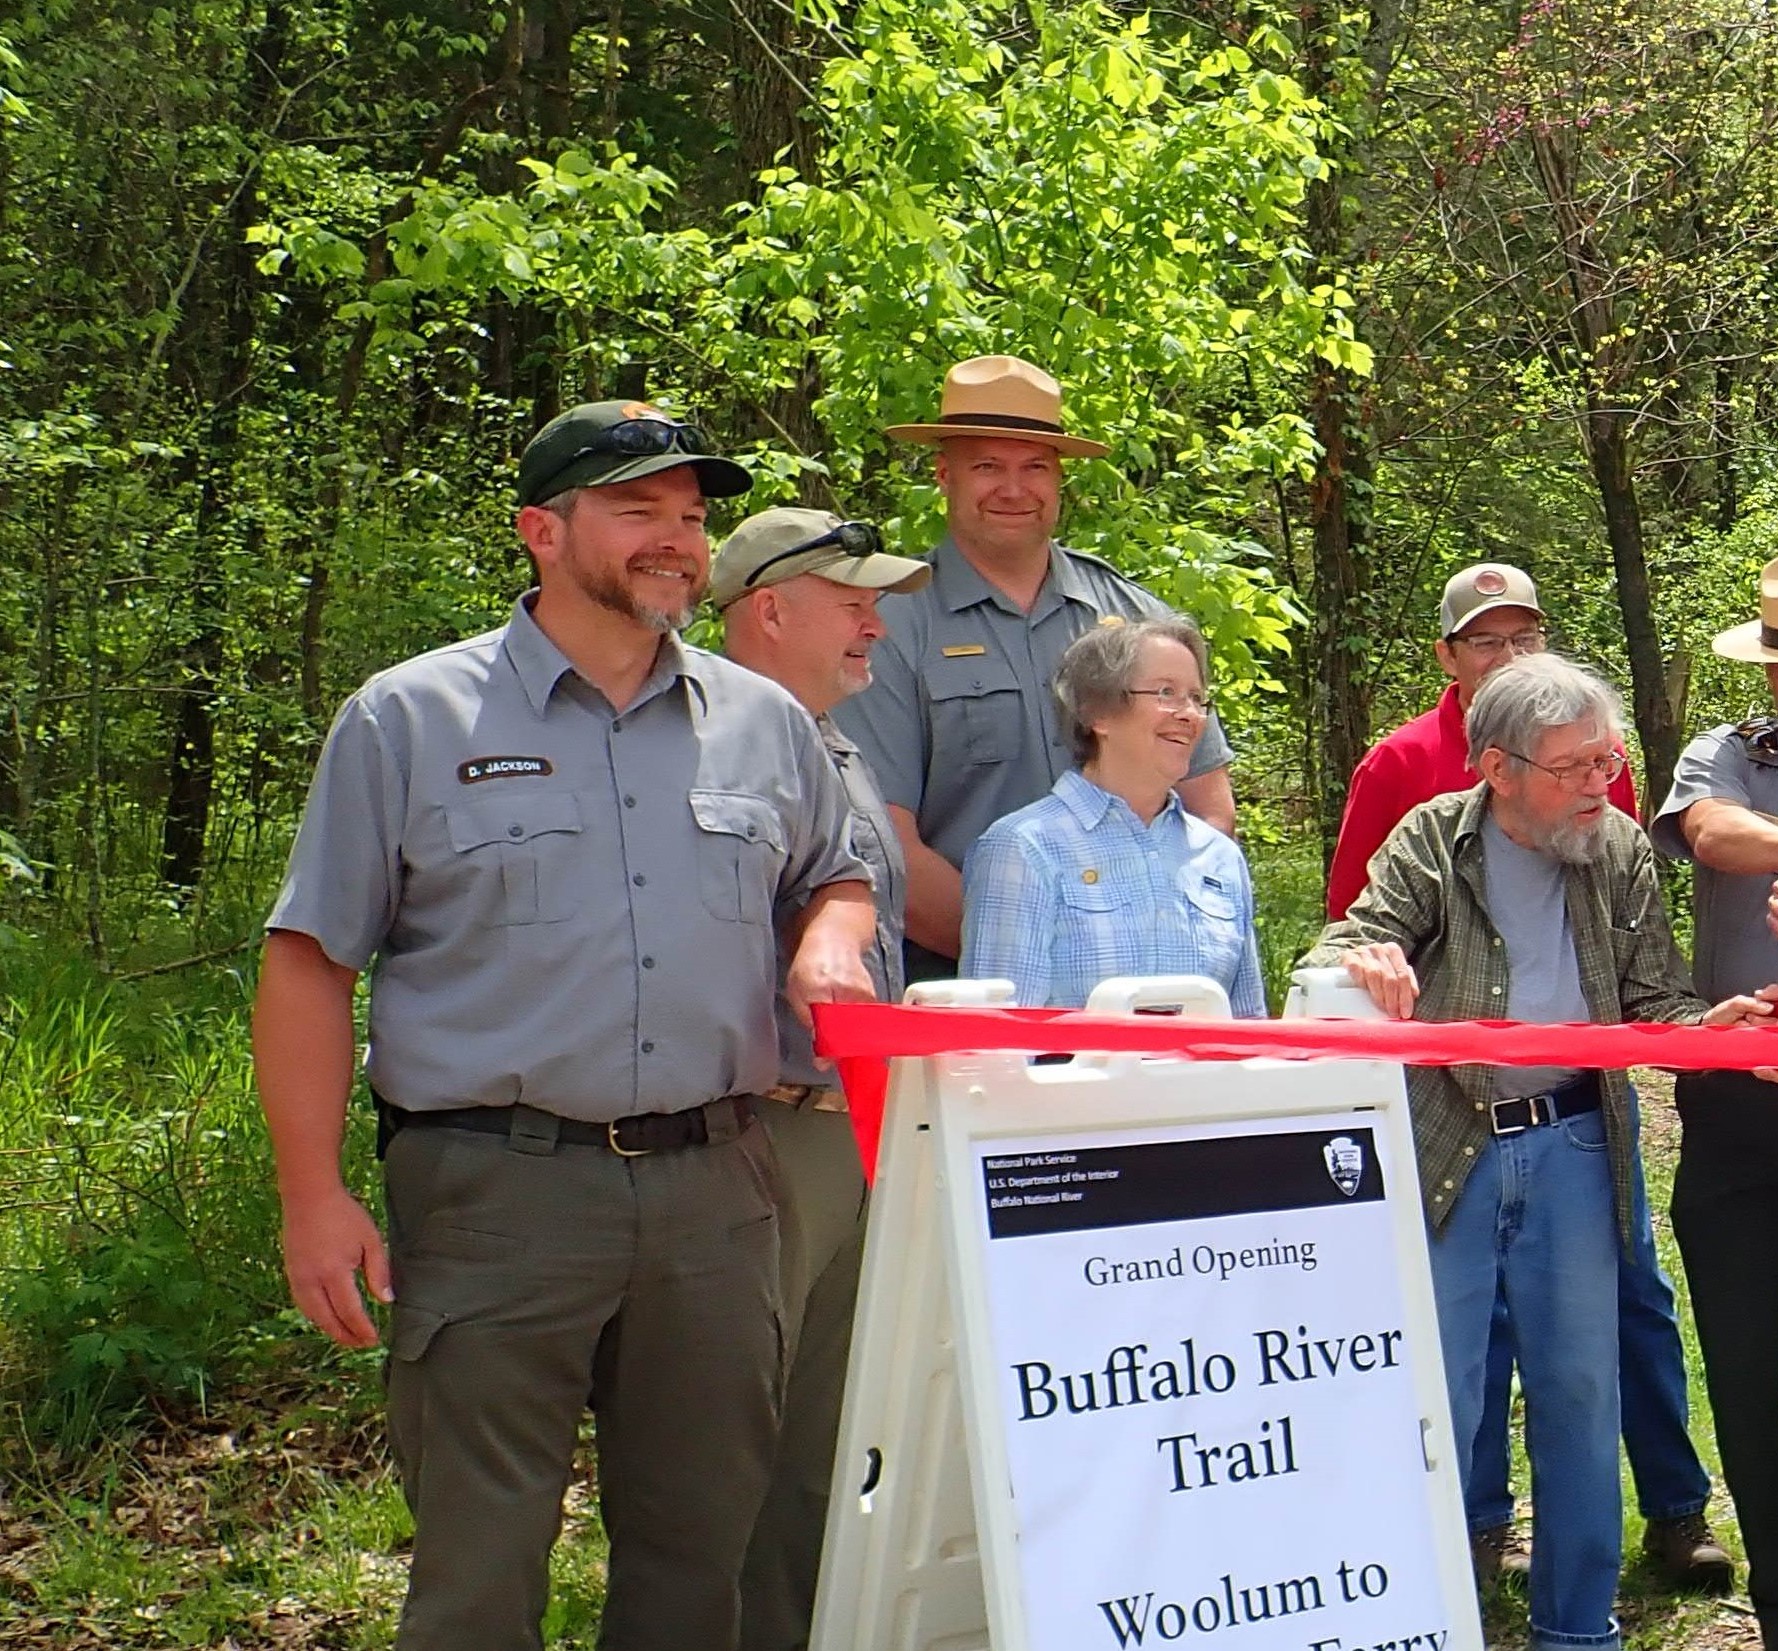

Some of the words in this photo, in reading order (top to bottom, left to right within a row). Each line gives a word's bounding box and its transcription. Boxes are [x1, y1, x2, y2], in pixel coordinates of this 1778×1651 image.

[468, 766, 481, 777] D.
[485, 761, 541, 774] JACKSON
[987, 1158, 1023, 1169] National
[1024, 1157, 1044, 1167] Park
[1045, 1155, 1077, 1165] Service
[989, 1178, 1007, 1189] U.S.
[1008, 1174, 1060, 1188] Department
[1061, 1173, 1070, 1182] of
[1072, 1172, 1087, 1181] the
[1087, 1170, 1119, 1180] Interior
[991, 1196, 1023, 1208] Buffalo
[1023, 1193, 1060, 1205] National
[1061, 1192, 1083, 1202] River
[1084, 1247, 1184, 1286] Grand
[1192, 1238, 1317, 1281] Opening
[1010, 1337, 1237, 1422] Buffalo
[1252, 1324, 1402, 1387] River
[1157, 1415, 1300, 1493] Trail
[1097, 1574, 1326, 1651] Woolum
[1335, 1560, 1389, 1603] to
